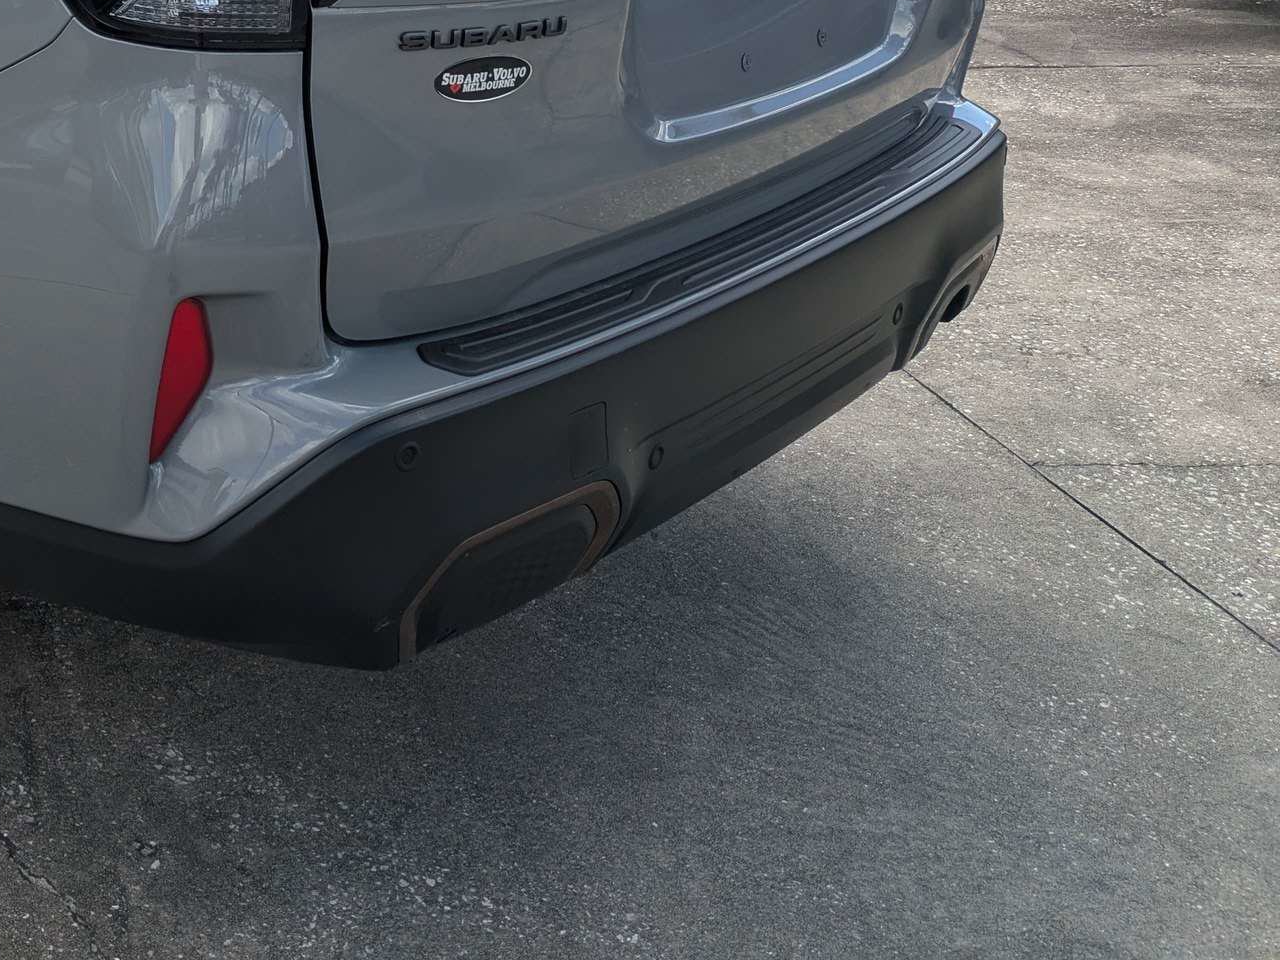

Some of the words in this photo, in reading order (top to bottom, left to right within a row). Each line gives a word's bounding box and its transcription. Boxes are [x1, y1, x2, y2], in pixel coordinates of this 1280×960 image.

[398, 15, 568, 52] SUBARU
[441, 72, 489, 86] SUBARU
[493, 66, 527, 80] VOLVO
[462, 78, 516, 93] MELBOURNE
